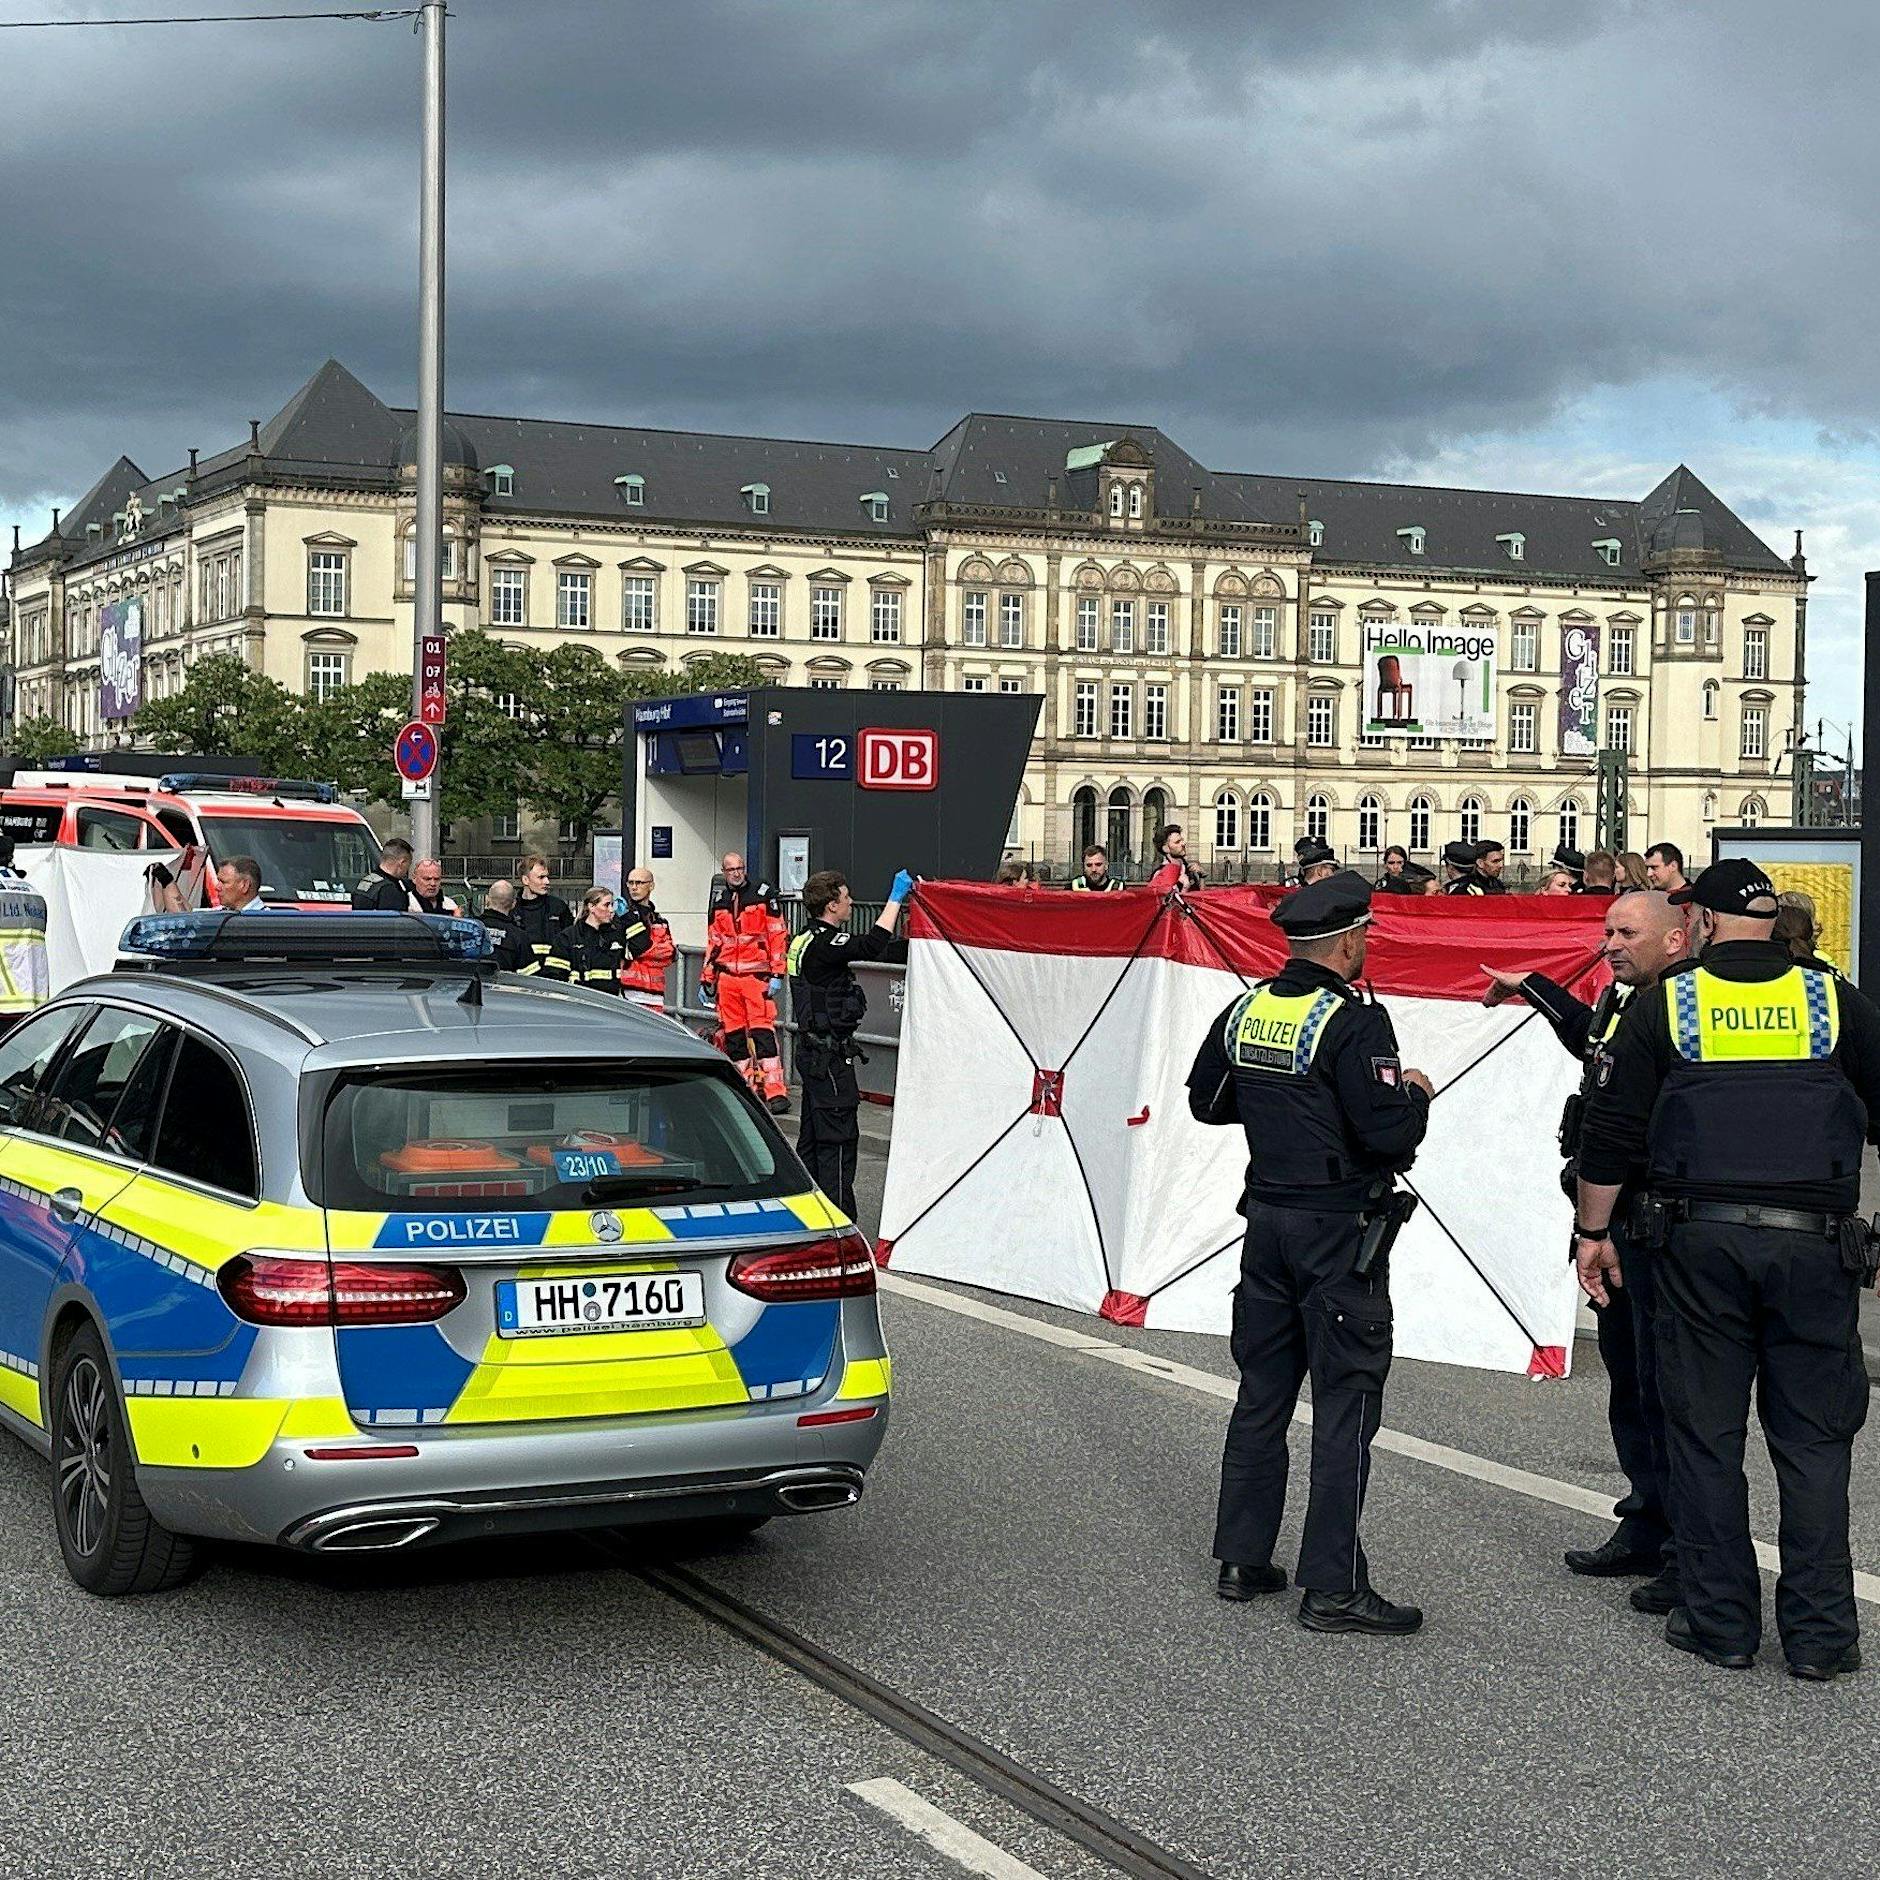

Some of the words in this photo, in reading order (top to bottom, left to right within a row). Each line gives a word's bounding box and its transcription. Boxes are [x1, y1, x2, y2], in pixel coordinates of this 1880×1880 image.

[426, 642, 441, 655] 01
[1367, 628, 1422, 652] Hello
[1428, 629, 1495, 662] Image
[426, 666, 440, 678] 07
[1565, 628, 1598, 726] Glitzer
[815, 738, 847, 769] 12
[870, 739, 928, 780] DB
[1241, 1017, 1298, 1046] POLIZEI
[1711, 1006, 1798, 1031] POLIZEI
[566, 1155, 608, 1178] 23/10
[406, 1218, 520, 1241] POLIZEI
[504, 1310, 513, 1322] D
[534, 1284, 580, 1321] HH
[602, 1279, 684, 1317] 7160
